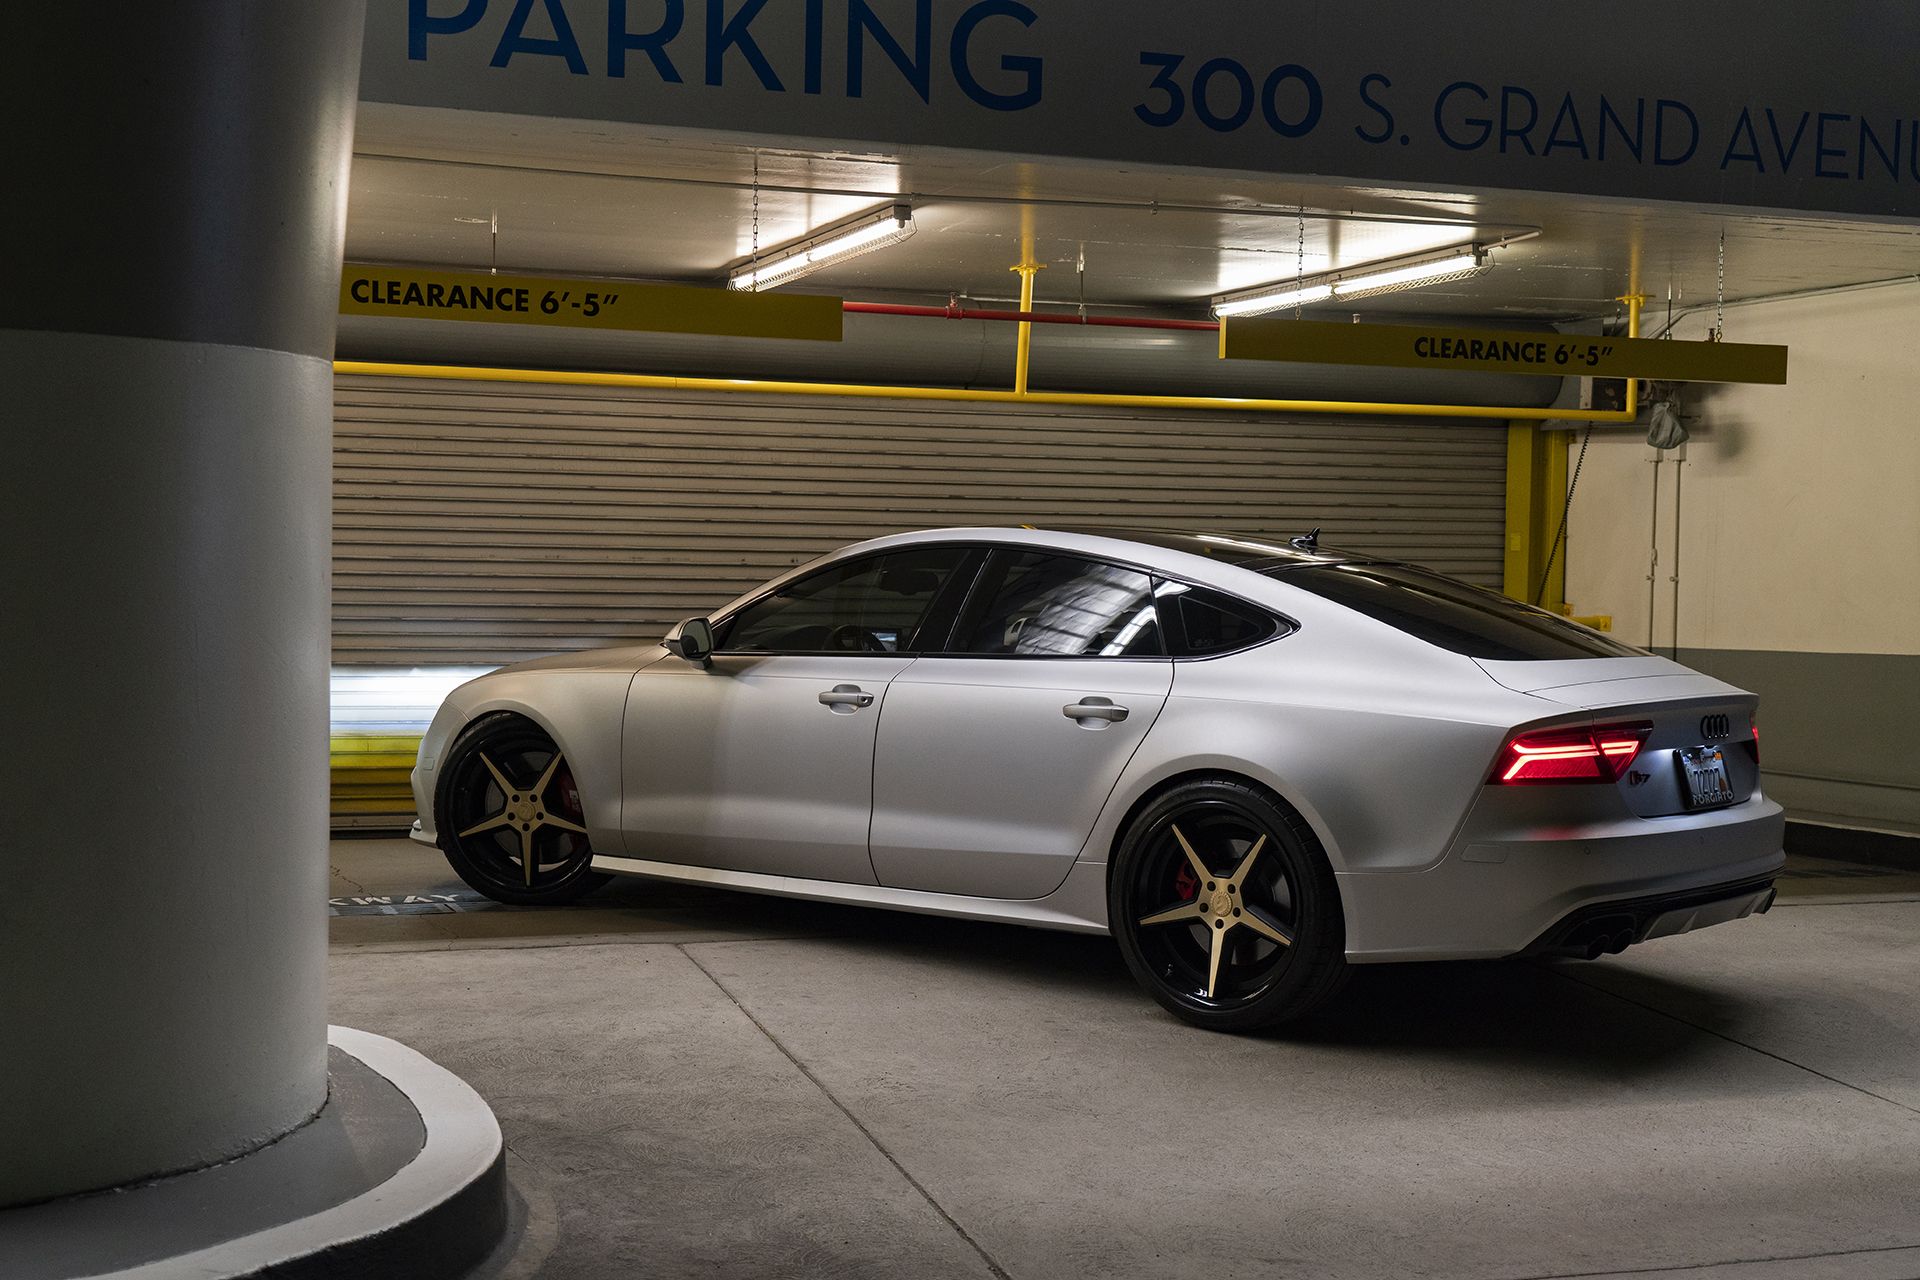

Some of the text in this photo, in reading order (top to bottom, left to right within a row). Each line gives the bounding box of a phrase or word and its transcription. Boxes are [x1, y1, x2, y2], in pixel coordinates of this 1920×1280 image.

[405, 0, 1044, 112] PARKING
[1133, 51, 1920, 182] 300 S. GRAND AVEN
[350, 278, 529, 313] CLEARANCE
[1414, 336, 1547, 363] CLEARANCE
[1692, 790, 1734, 806] FORGIATO
